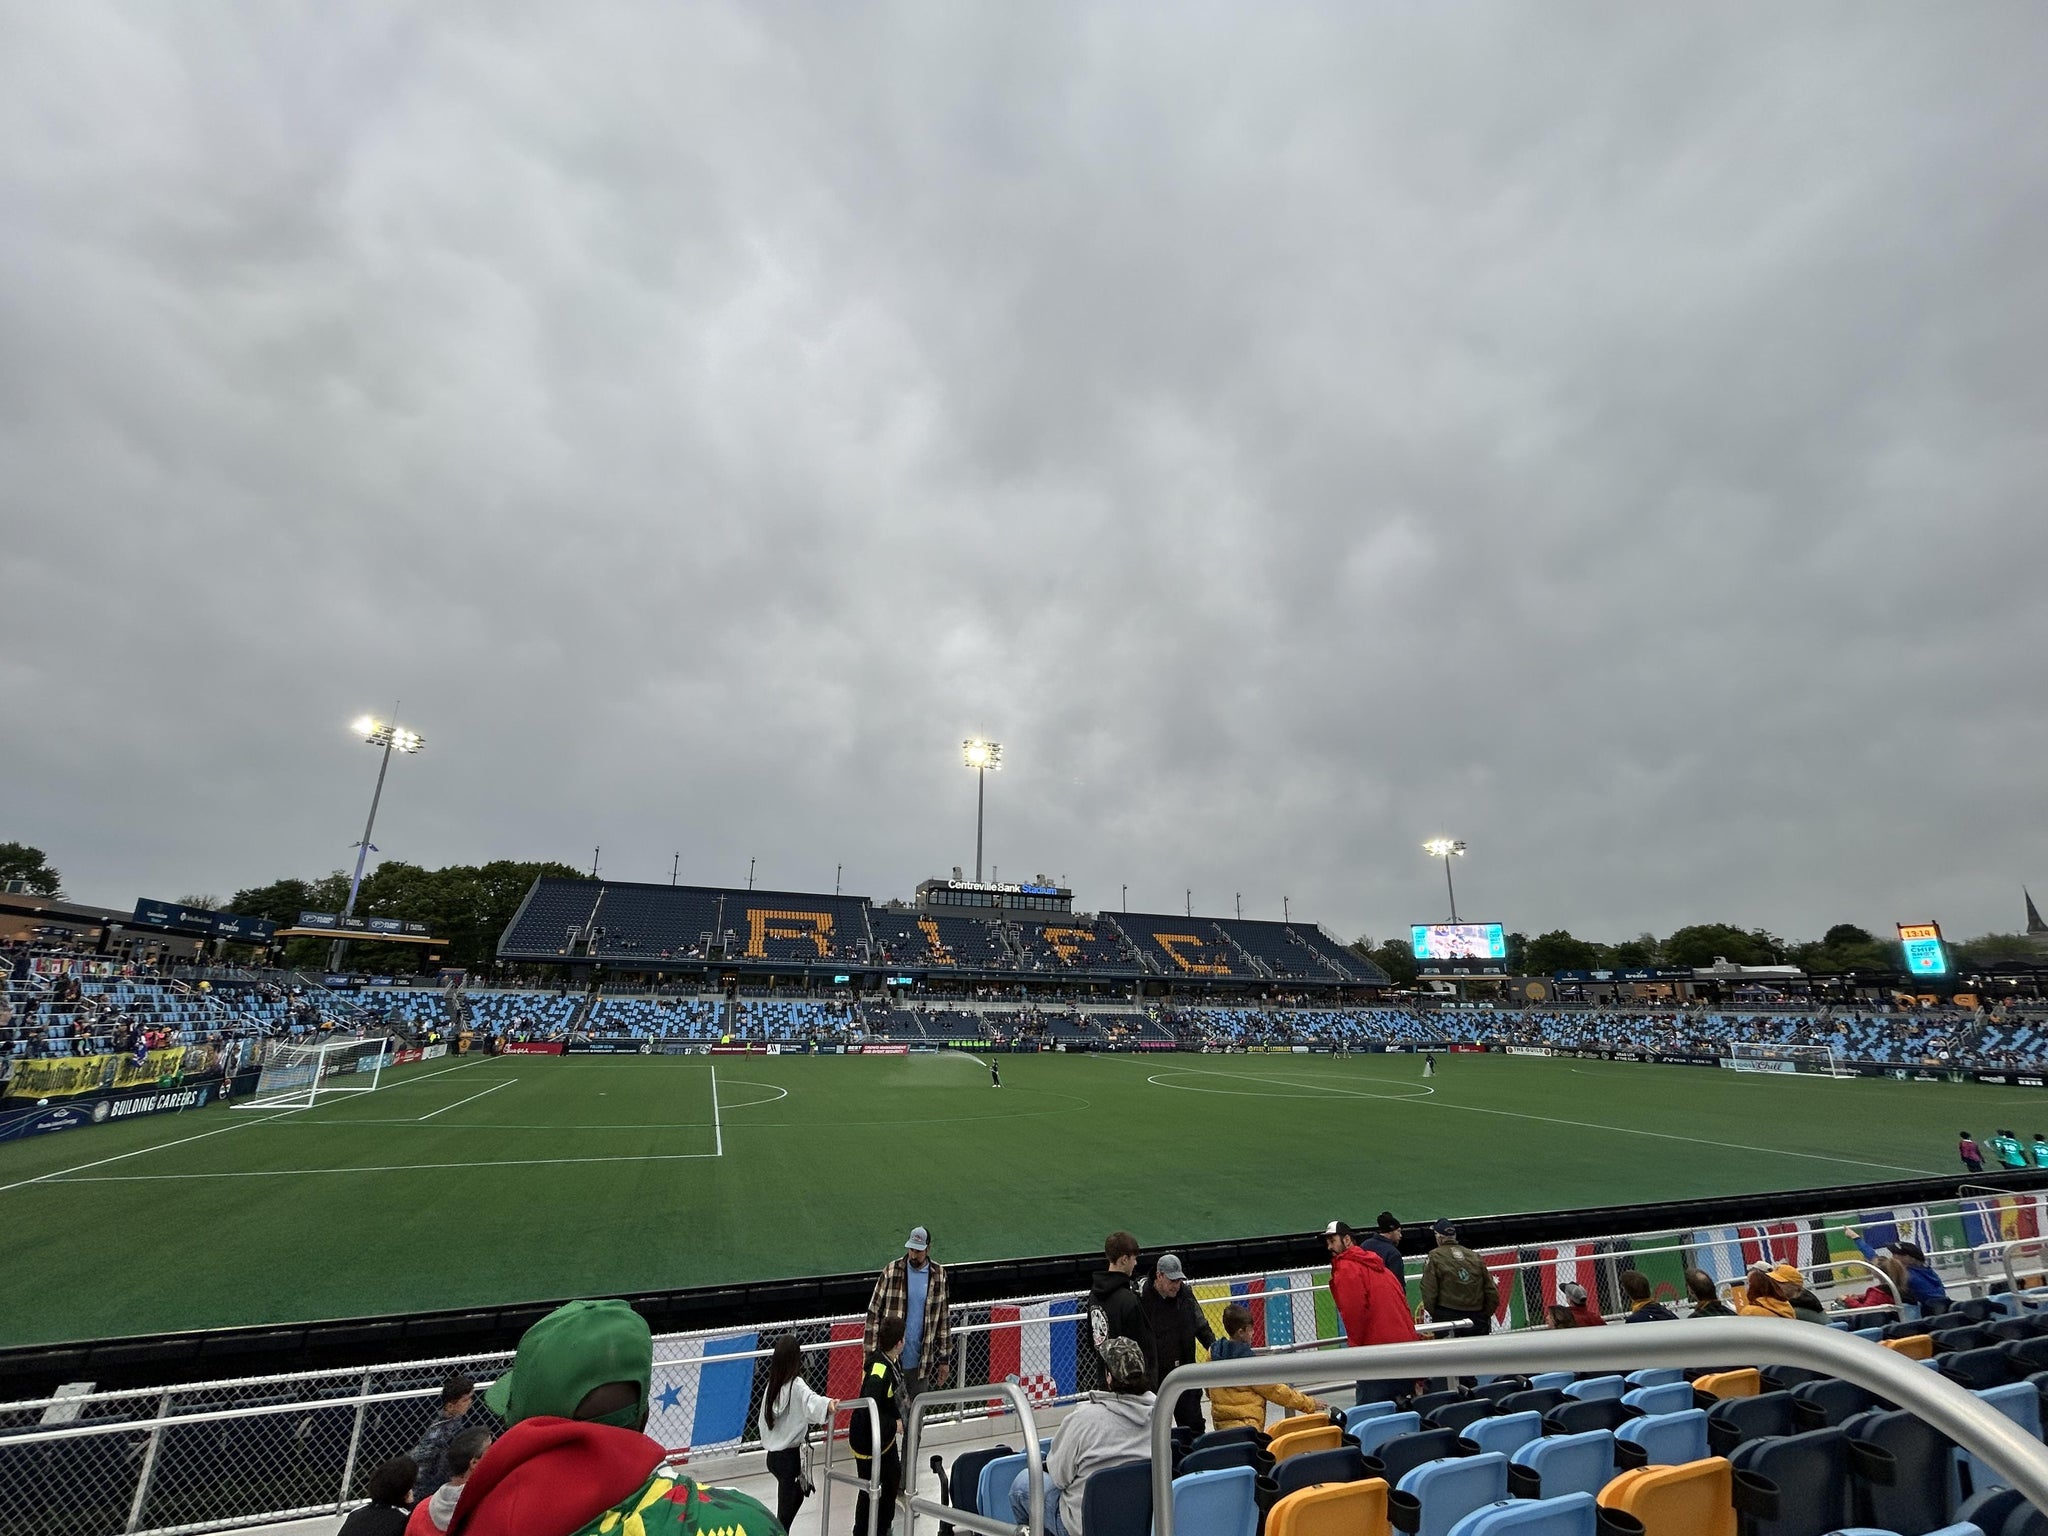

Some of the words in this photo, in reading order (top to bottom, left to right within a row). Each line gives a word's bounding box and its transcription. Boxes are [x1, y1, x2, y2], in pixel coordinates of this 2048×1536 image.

[947, 879, 997, 892] Centreville
[998, 882, 1021, 894] Bank
[1021, 884, 1058, 896] Stadium
[218, 922, 240, 933] Breeze
[110, 1096, 156, 1117] BUILDING
[156, 1091, 198, 1110] CAREERS
